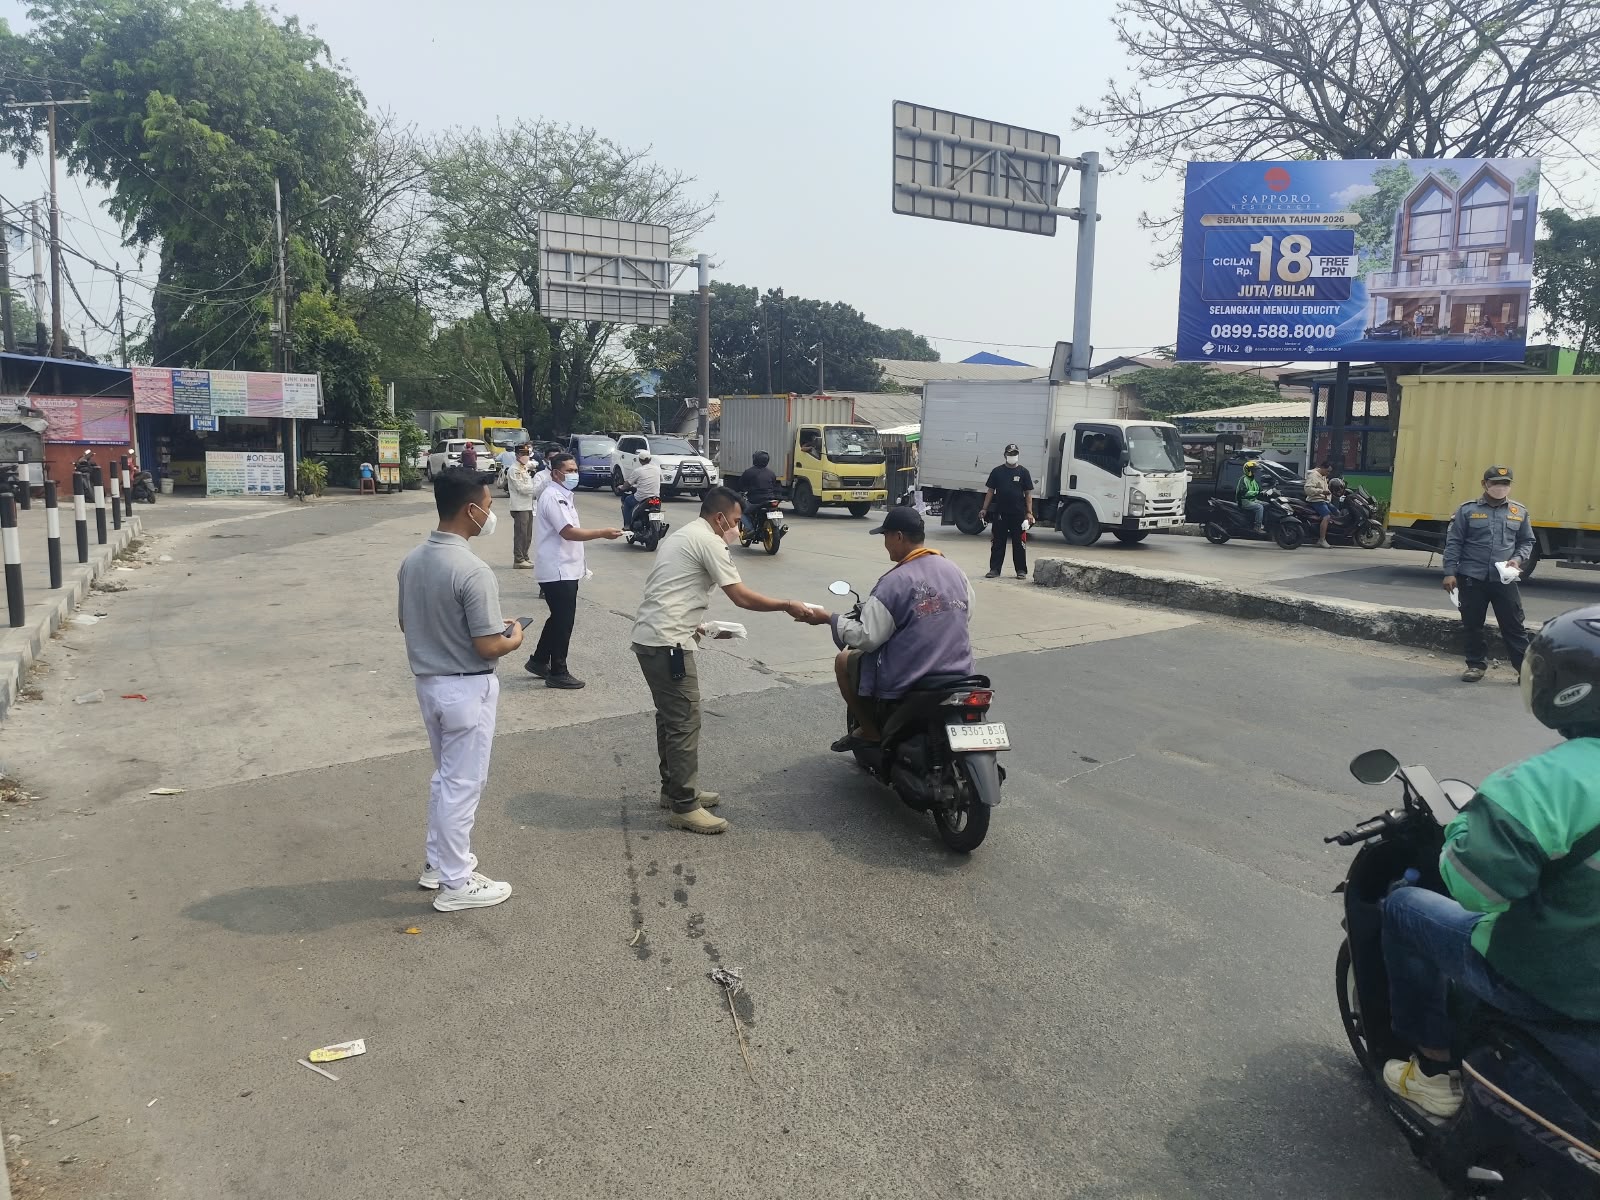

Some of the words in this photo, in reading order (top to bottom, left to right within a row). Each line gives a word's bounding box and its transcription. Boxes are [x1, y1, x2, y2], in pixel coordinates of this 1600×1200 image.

[1241, 194, 1311, 204] SAPPORO
[1217, 215, 1248, 224] SERAH
[1251, 215, 1286, 224] TERIMA
[1289, 215, 1321, 223] TAHUN
[1323, 215, 1345, 223] 2026
[1212, 257, 1253, 266] CICILAN
[1250, 234, 1313, 283] 18
[1319, 257, 1349, 266] FREE
[1236, 267, 1253, 276] Rp.
[1321, 267, 1346, 277] PPN
[1237, 284, 1315, 299] JUTA/BULAN
[1209, 305, 1261, 315] SELANGKAH
[1263, 305, 1300, 315] MENUJU
[1302, 305, 1341, 315] EDUCITY
[1210, 324, 1336, 339] 0899.588.8000
[1217, 344, 1240, 353] PIK2
[951, 726, 958, 736] B
